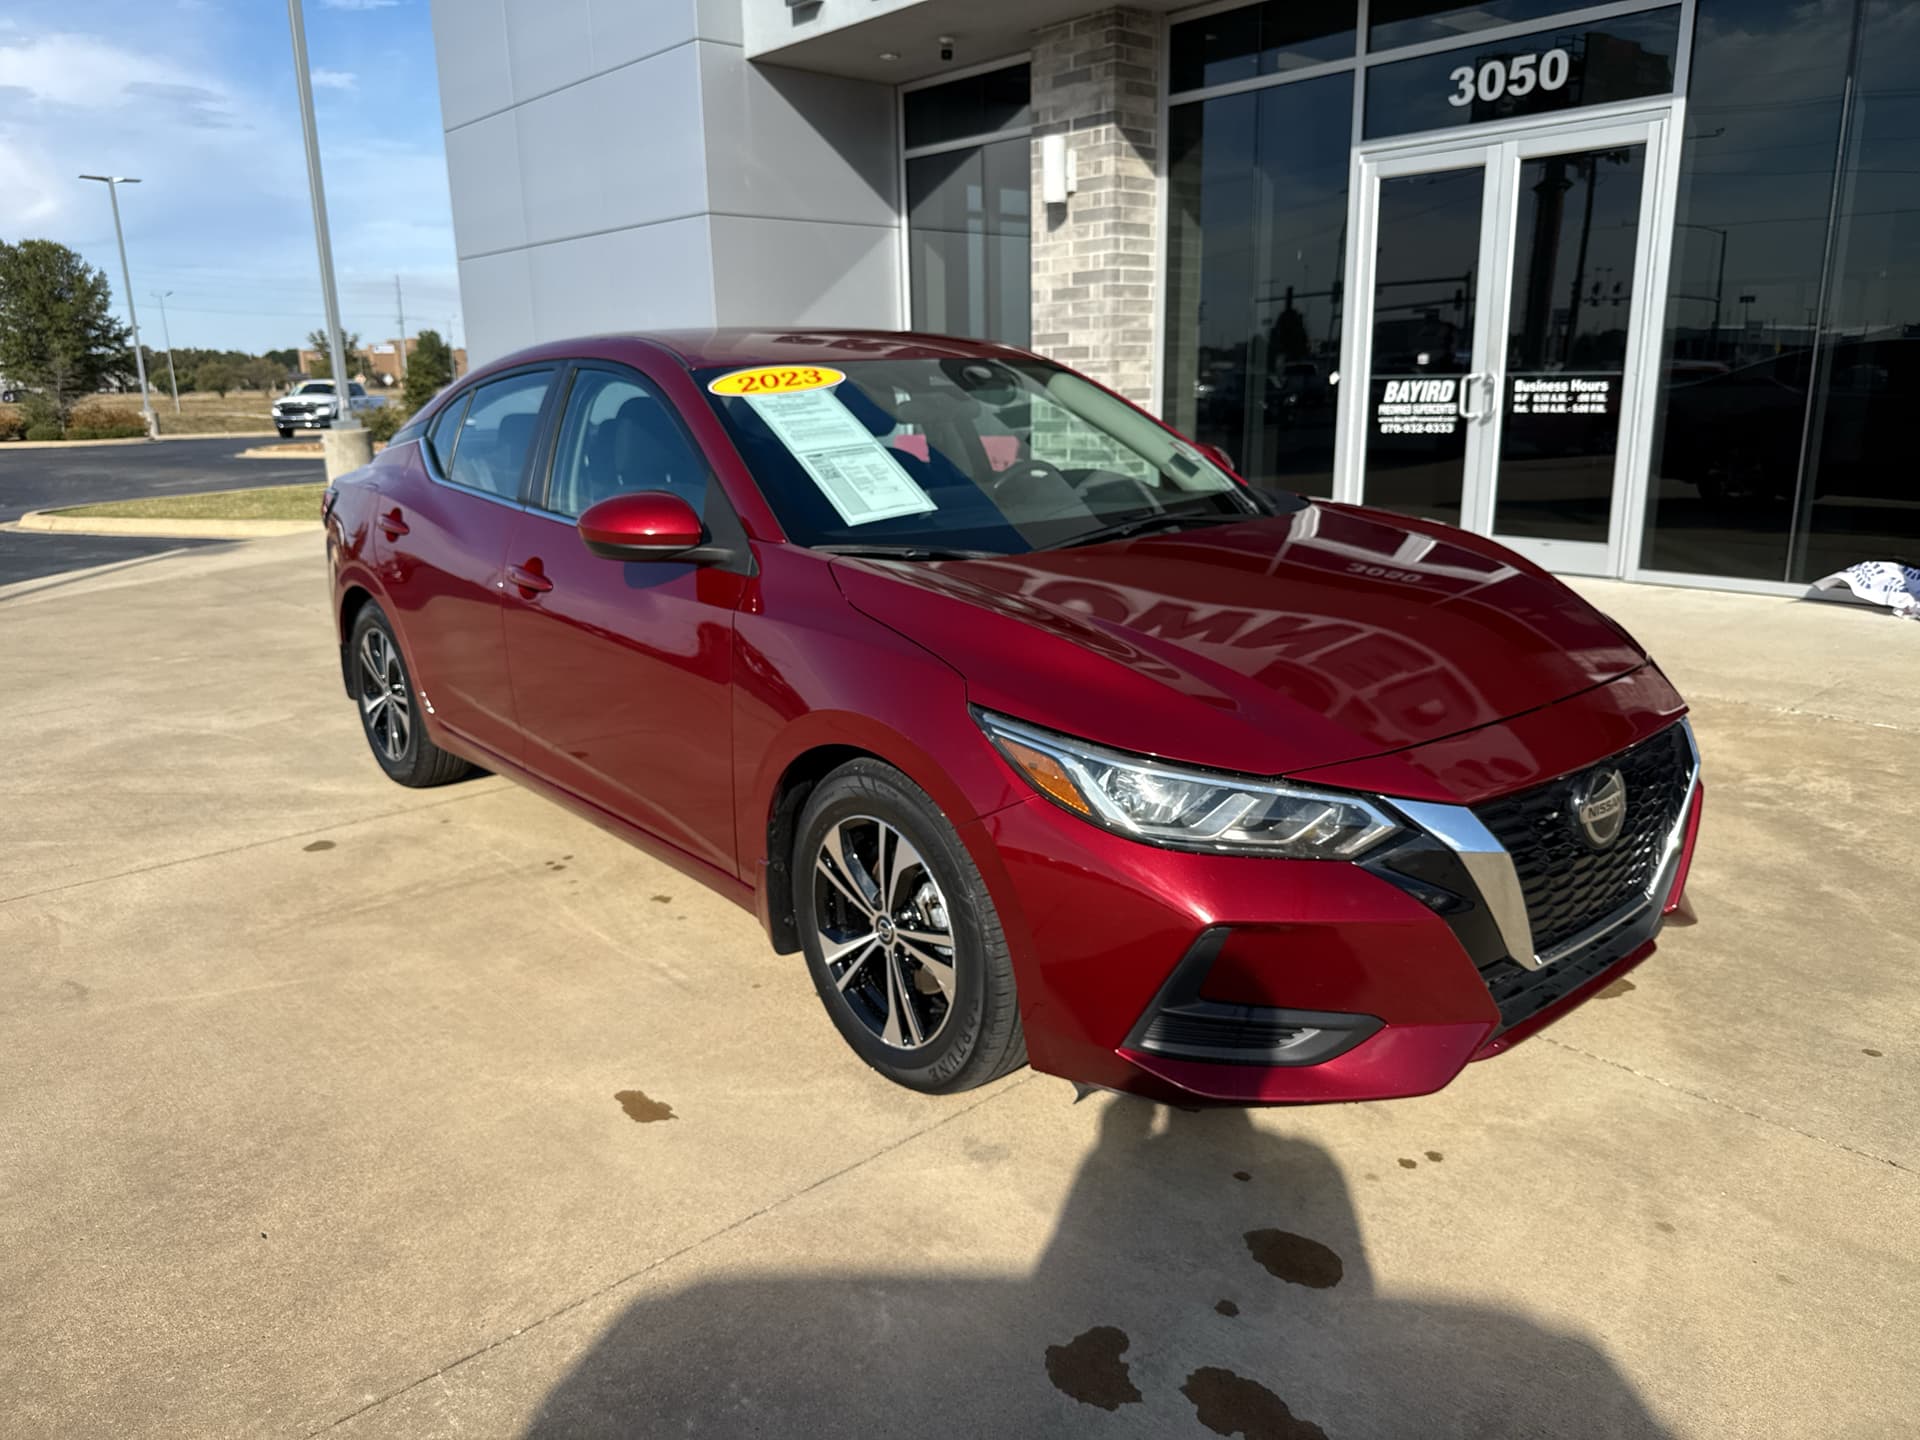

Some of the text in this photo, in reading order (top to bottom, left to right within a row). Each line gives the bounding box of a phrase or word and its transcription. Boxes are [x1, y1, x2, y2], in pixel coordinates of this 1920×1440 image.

[1448, 49, 1569, 106] 3050
[738, 369, 824, 393] 2023
[1383, 380, 1456, 402] BAYIRD
[1514, 379, 1609, 392] Business Hours
[1587, 795, 1620, 819] NISSAN
